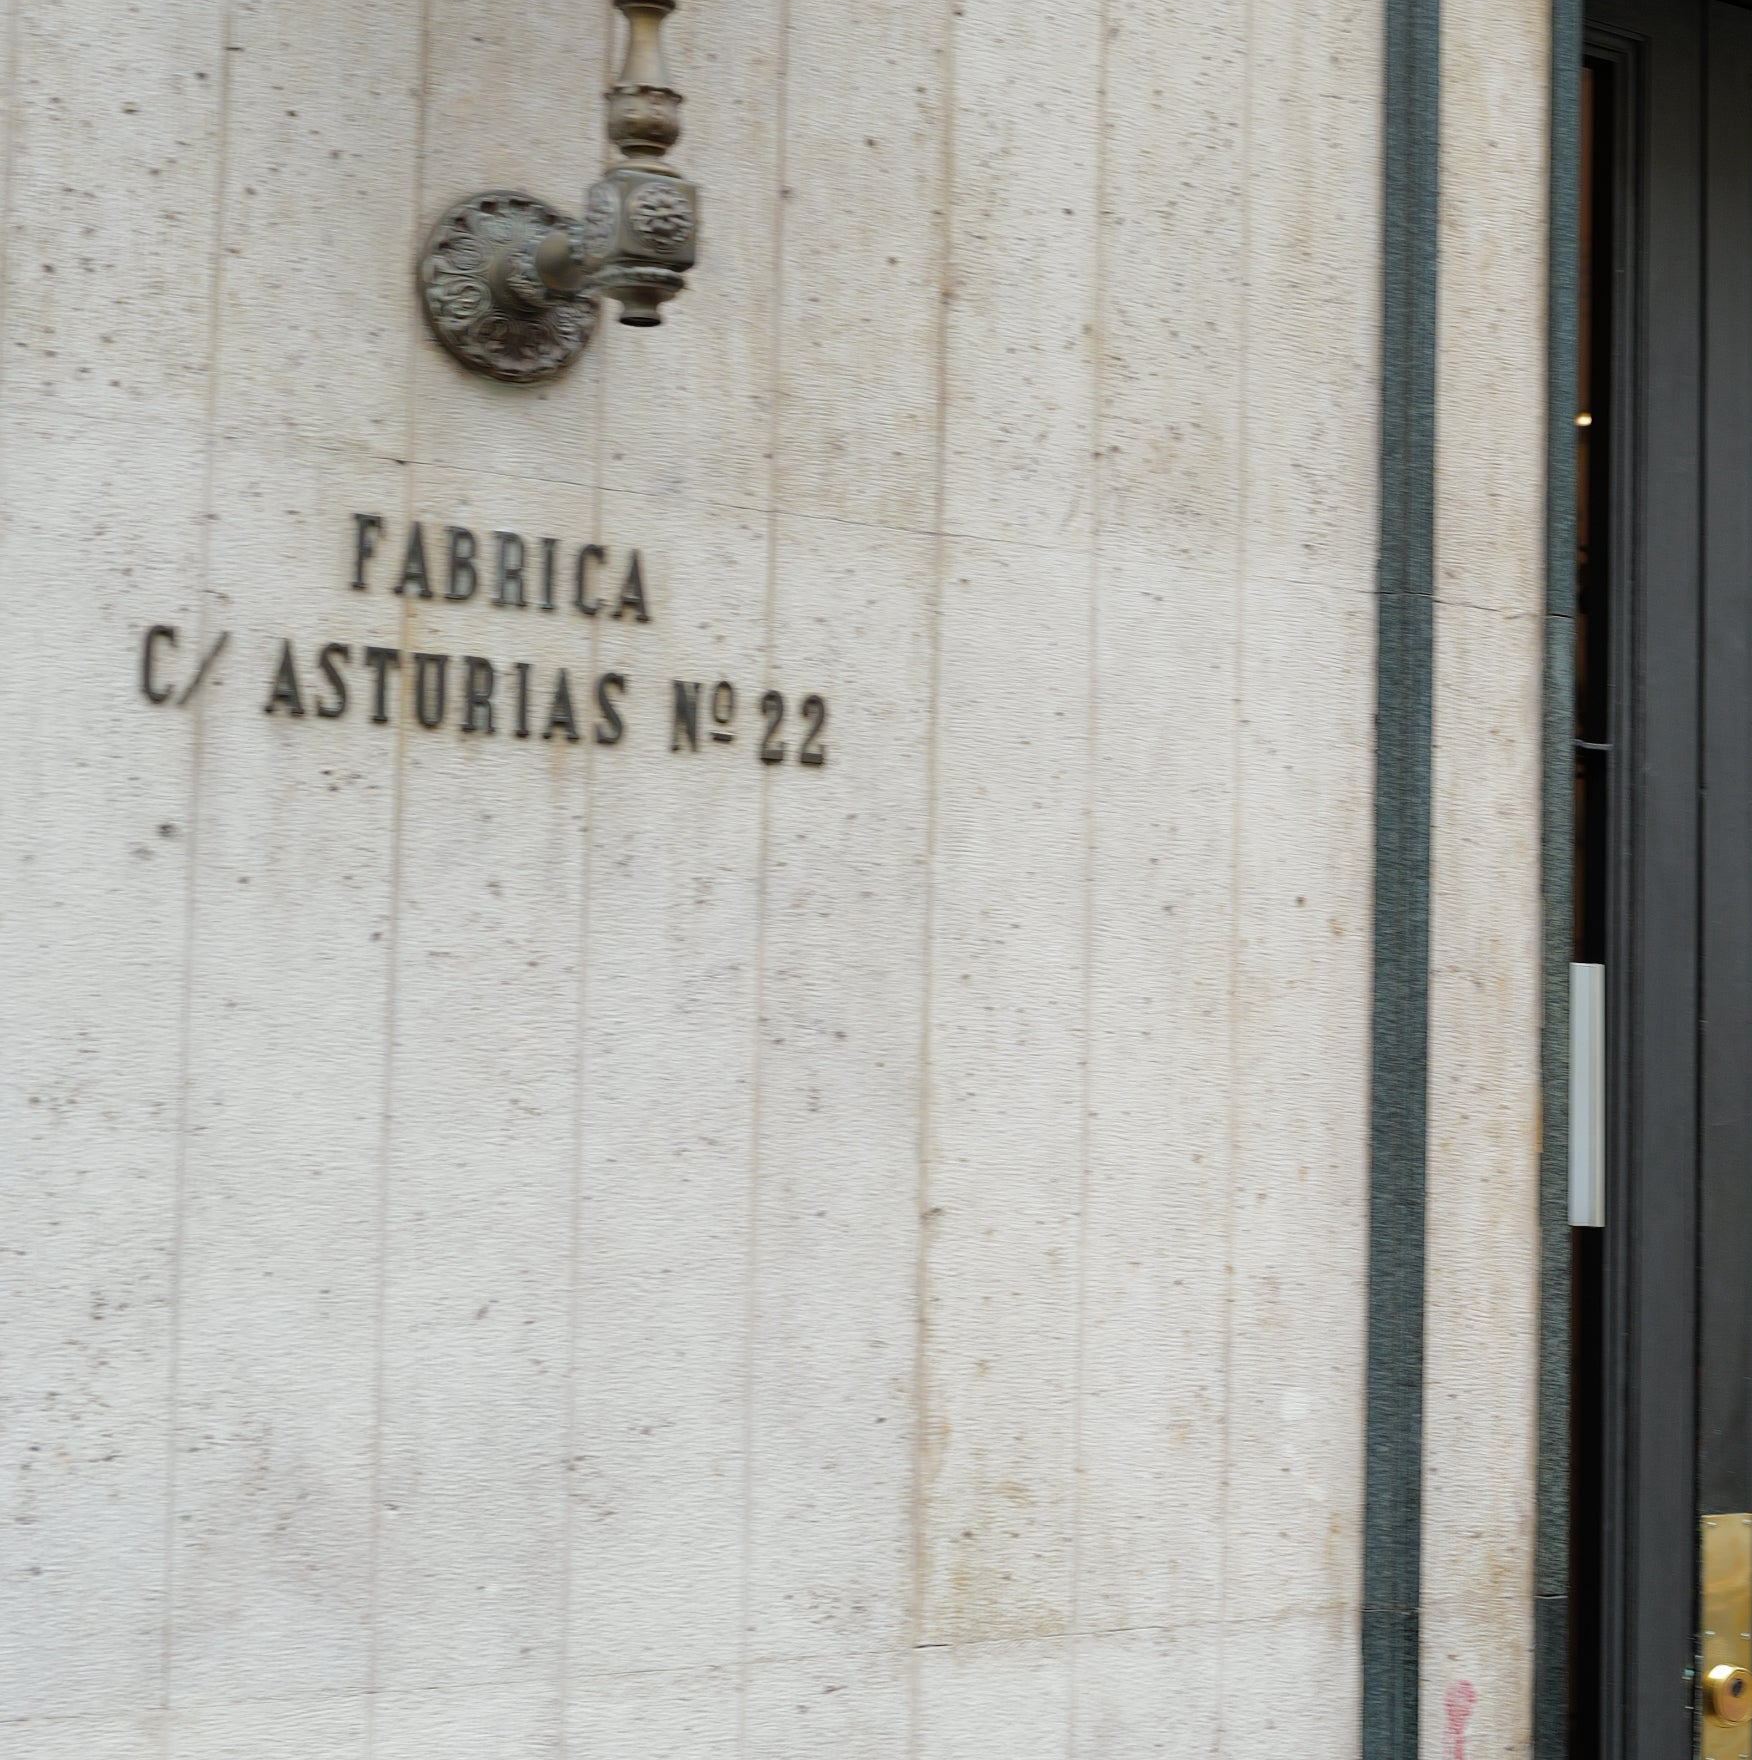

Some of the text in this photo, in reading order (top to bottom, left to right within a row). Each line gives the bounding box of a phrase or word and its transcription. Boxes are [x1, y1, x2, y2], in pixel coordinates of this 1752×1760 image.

[350, 512, 652, 624] FABRICA
[139, 624, 231, 706] C/
[263, 639, 629, 745] ASTURIAS
[759, 689, 829, 766] 22
